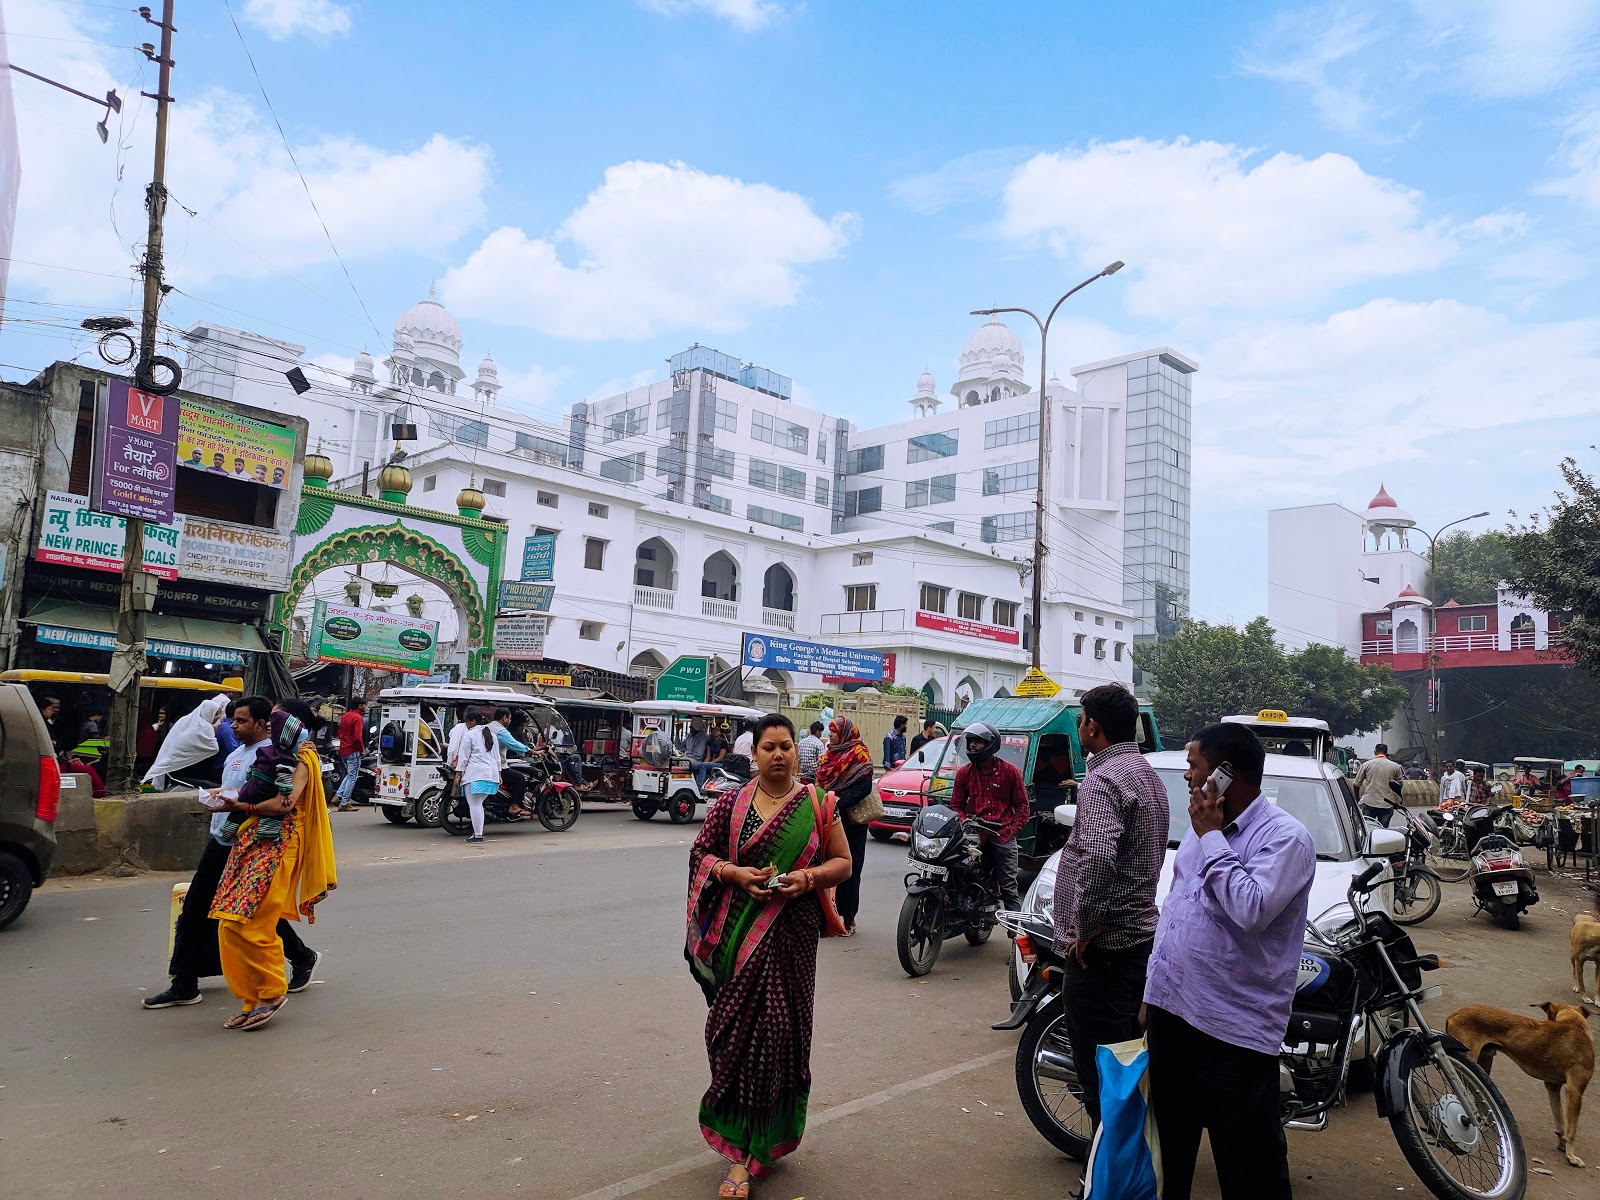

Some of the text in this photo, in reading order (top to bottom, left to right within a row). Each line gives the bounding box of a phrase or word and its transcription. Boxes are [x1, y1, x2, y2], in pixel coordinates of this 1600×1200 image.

[137, 393, 156, 417] V
[130, 413, 159, 431] MART
[113, 461, 130, 474] For
[50, 495, 73, 503] NASIR
[113, 488, 133, 500] Gold
[133, 494, 153, 504] Coin
[49, 508, 71, 533] न्यू
[45, 533, 73, 550] NEW
[74, 538, 118, 557] PRINCE
[186, 552, 266, 569] CHEMIST & DRUGGIST
[505, 583, 548, 597] PHOTOCOPY
[157, 589, 259, 610] PIONEER MEDICALS
[44, 629, 66, 641] NEW
[66, 632, 99, 645] PRINCE
[153, 644, 237, 662] PIONEER MEDICALS
[769, 640, 788, 651] King
[788, 642, 820, 656] George's
[821, 647, 848, 658] Medical
[849, 650, 882, 664] University
[793, 652, 814, 660] Faculty
[822, 655, 841, 663] Dental
[679, 666, 701, 674] PWD
[925, 812, 949, 822] PRESS
